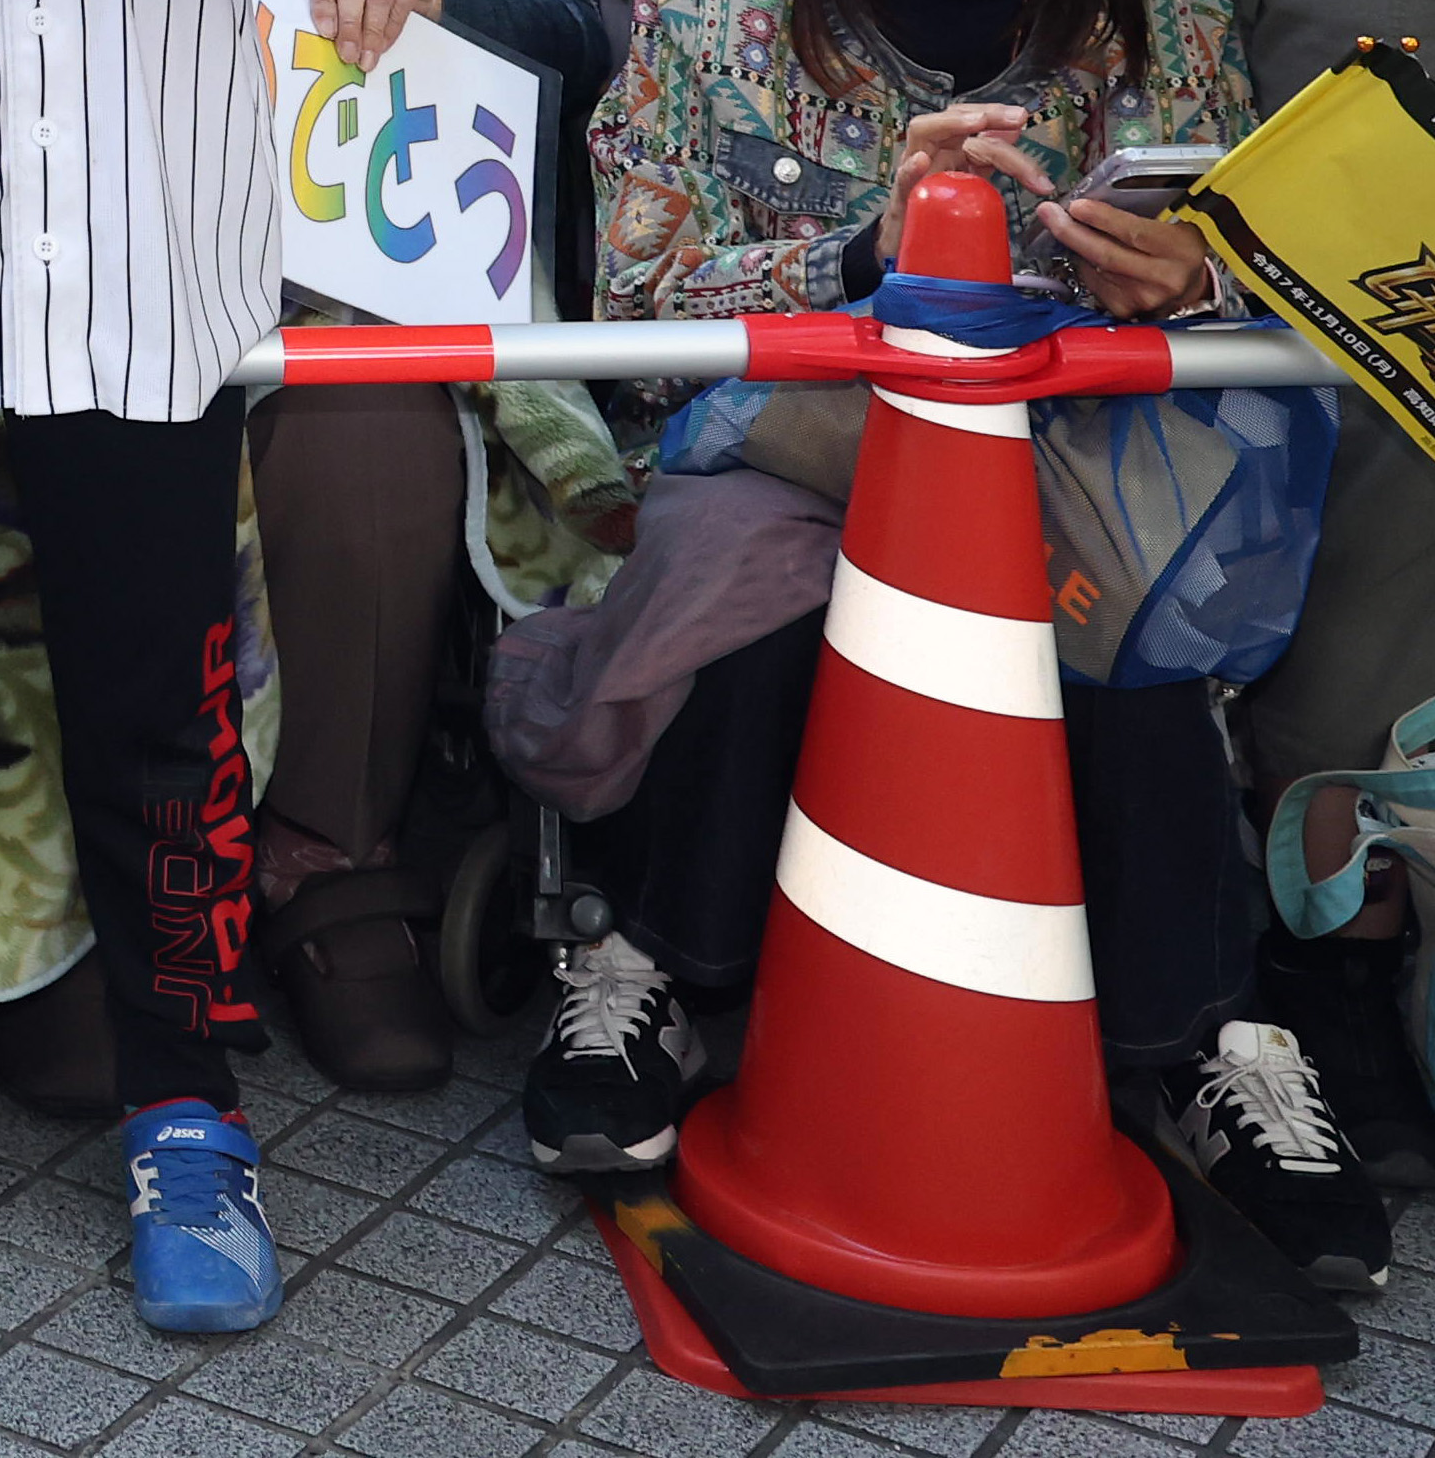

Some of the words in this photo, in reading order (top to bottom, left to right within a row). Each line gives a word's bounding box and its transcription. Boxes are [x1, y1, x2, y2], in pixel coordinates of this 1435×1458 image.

[255, 2, 527, 300] でとう
[172, 1127, 205, 1140] asics
